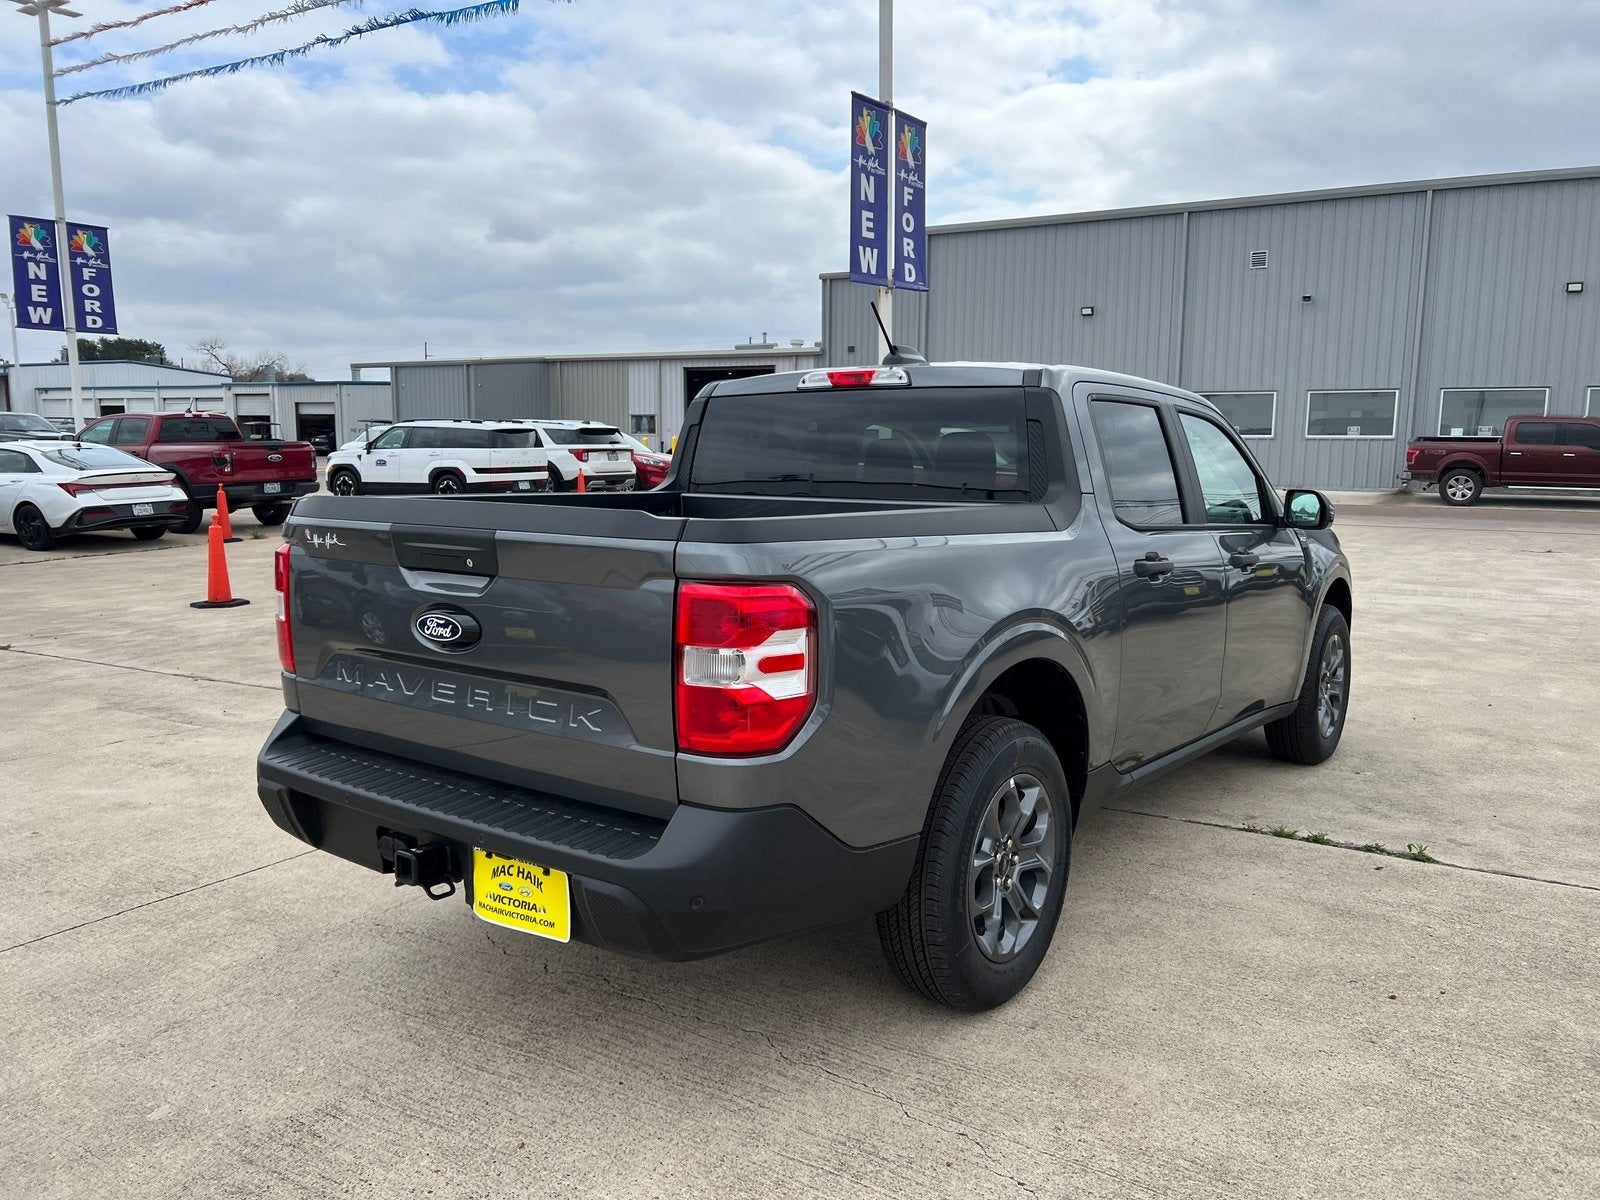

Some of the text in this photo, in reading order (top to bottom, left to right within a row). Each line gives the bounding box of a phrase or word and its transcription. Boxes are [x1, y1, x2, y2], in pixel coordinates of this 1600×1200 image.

[858, 173, 878, 276] NEW
[902, 185, 916, 283] FORD
[27, 262, 52, 324] NEW
[81, 267, 103, 328] FORD
[424, 617, 453, 638] Ford
[336, 661, 602, 732] MAVERICK
[491, 865, 544, 894] MAC HAIK
[493, 893, 538, 913] VICTORIA
